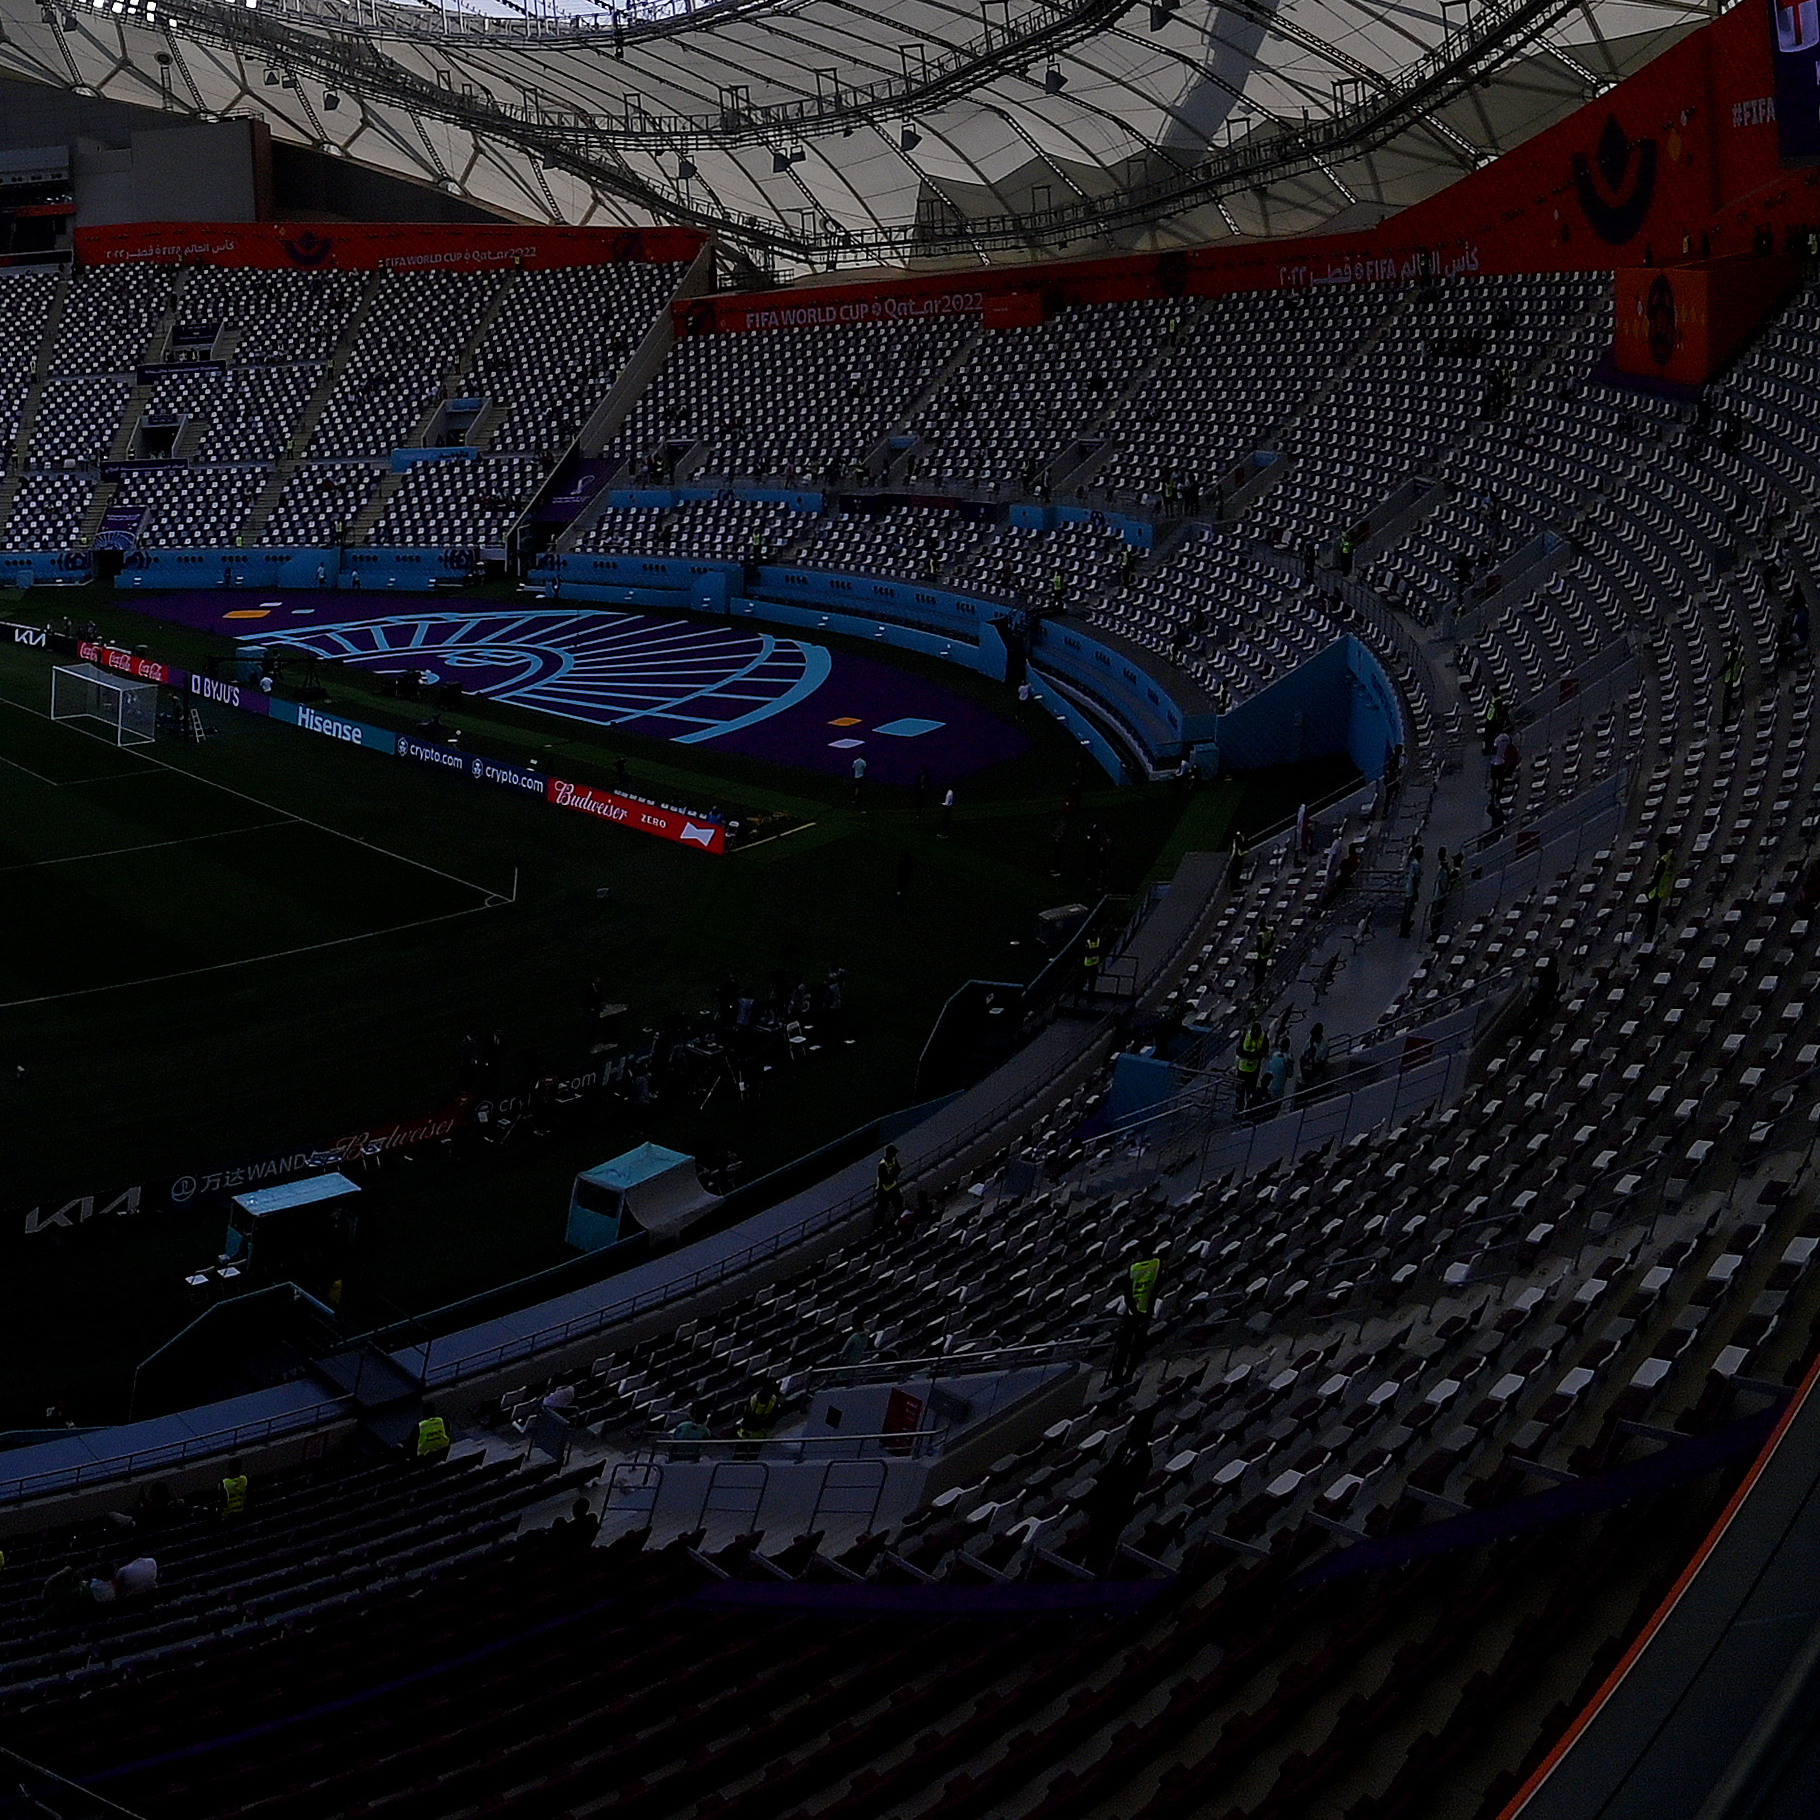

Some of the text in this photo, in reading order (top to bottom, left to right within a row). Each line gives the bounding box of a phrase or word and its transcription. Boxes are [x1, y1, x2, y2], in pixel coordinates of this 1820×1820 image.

[162, 245, 182, 256] FIFA
[385, 257, 406, 268] FIFA
[406, 254, 442, 267] WORLD
[443, 251, 462, 262] CUP
[1366, 258, 1396, 281] FIFA
[1401, 251, 1439, 280] الالم
[746, 293, 983, 328] FIFA WORLD CUP Qatar2022
[204, 677, 240, 707] BYJU'S
[297, 703, 362, 744] Hisense
[410, 742, 463, 770] crypto.com
[485, 765, 544, 794] crypto.com
[554, 780, 667, 829] Budweiser ZERO
[246, 1153, 311, 1182] WAND
[23, 1185, 143, 1235] KIA
